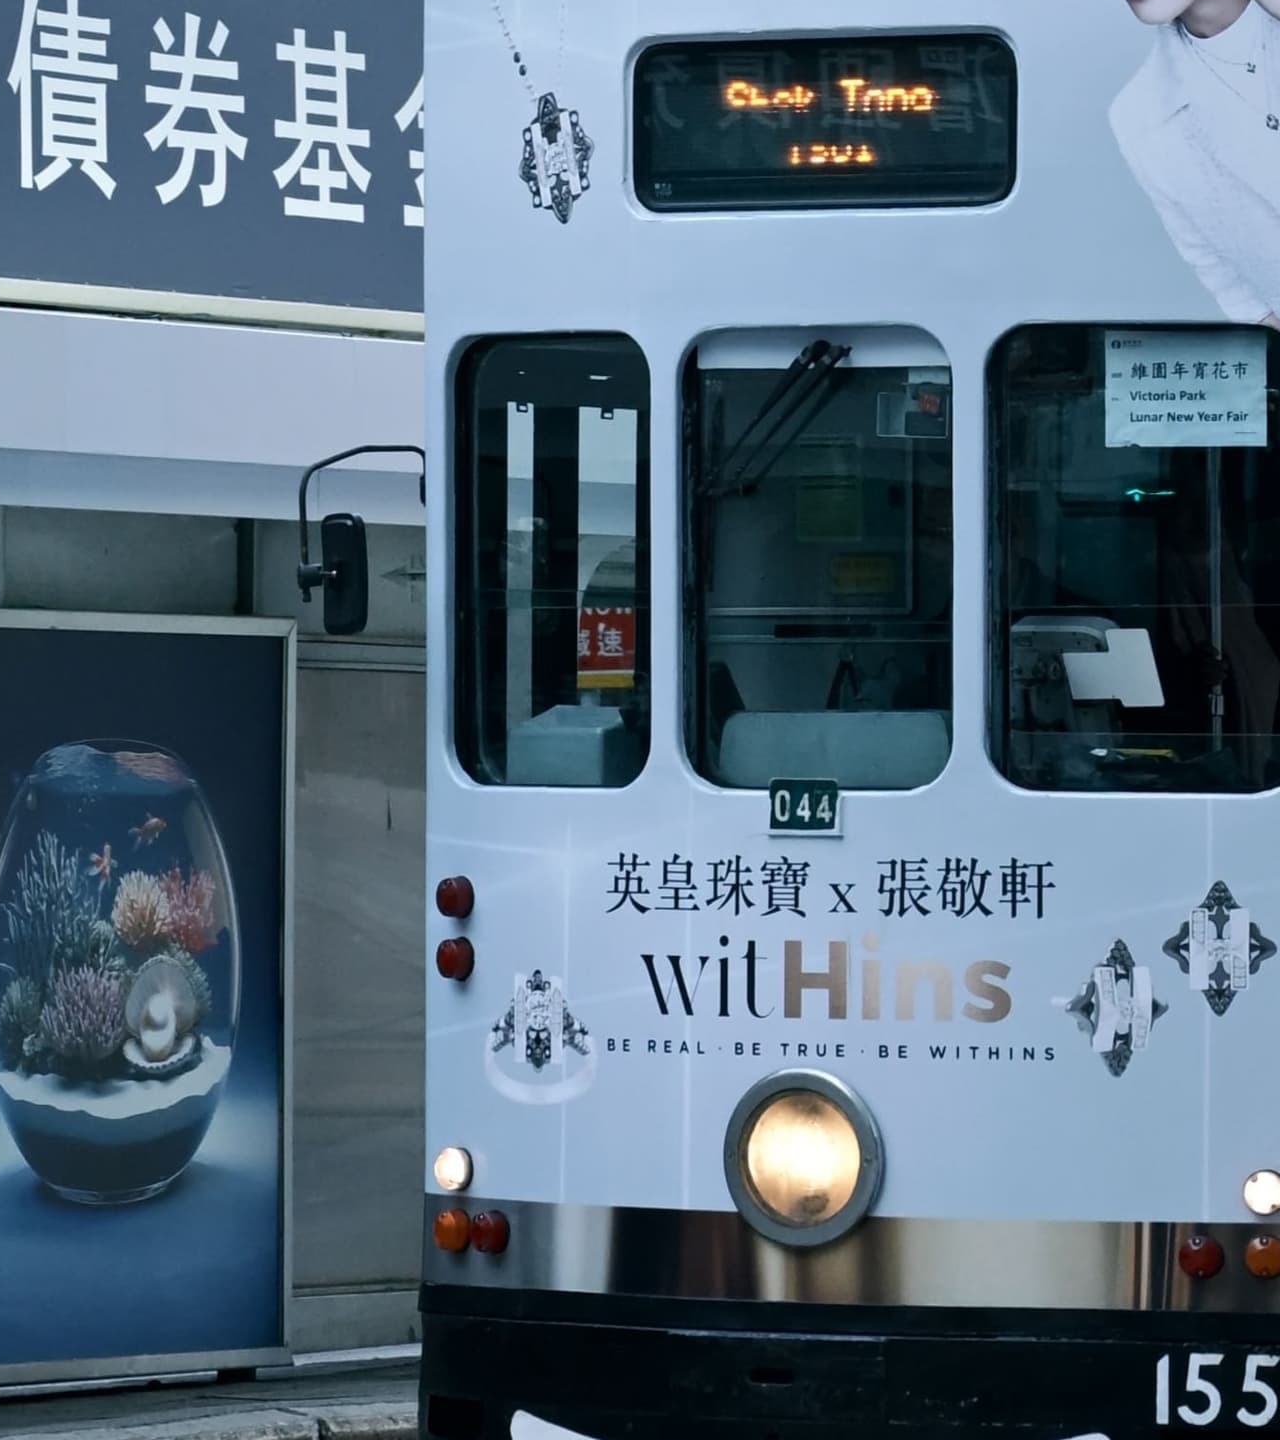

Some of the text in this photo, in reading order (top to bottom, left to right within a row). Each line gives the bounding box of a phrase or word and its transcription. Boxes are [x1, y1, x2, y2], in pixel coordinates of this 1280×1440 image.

[1130, 361, 1249, 380] 維園年宵花市
[1130, 390, 1176, 401] Victoria
[1179, 390, 1206, 401] Park
[1130, 411, 1249, 423] Lunar New Year Fair
[773, 790, 835, 825] 044
[605, 852, 1055, 920] 英皇珠寶 x 張敬軒
[640, 934, 1013, 1023] witHins
[607, 1038, 1057, 1062] BE REAL BE TRUE BE WITHINS
[1154, 1353, 1280, 1427] 155
